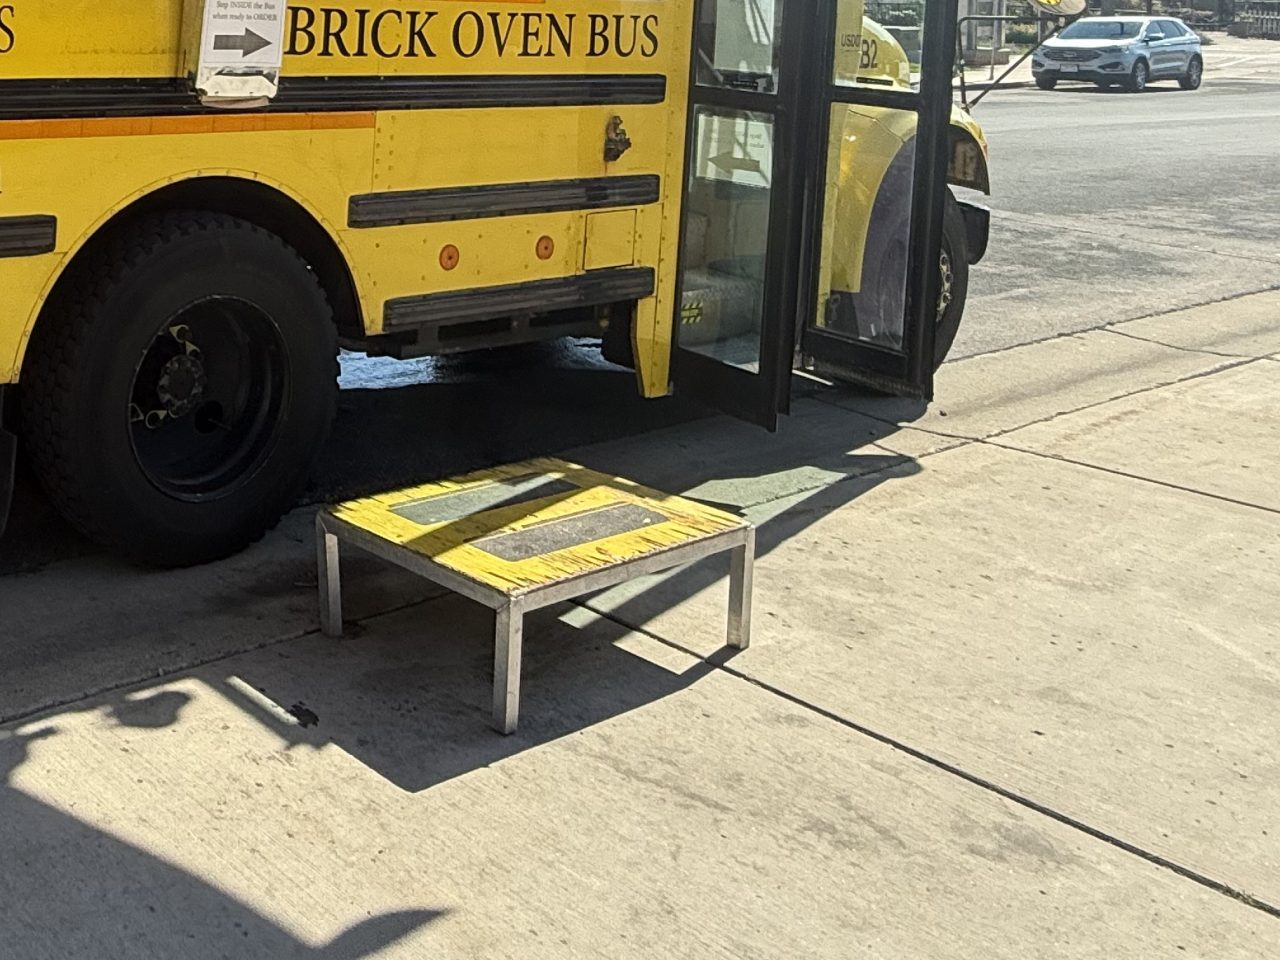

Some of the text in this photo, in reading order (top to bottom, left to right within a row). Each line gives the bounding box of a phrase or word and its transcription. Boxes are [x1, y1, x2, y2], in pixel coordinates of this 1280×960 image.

[284, 6, 659, 58] BRICK OVEN BUS
